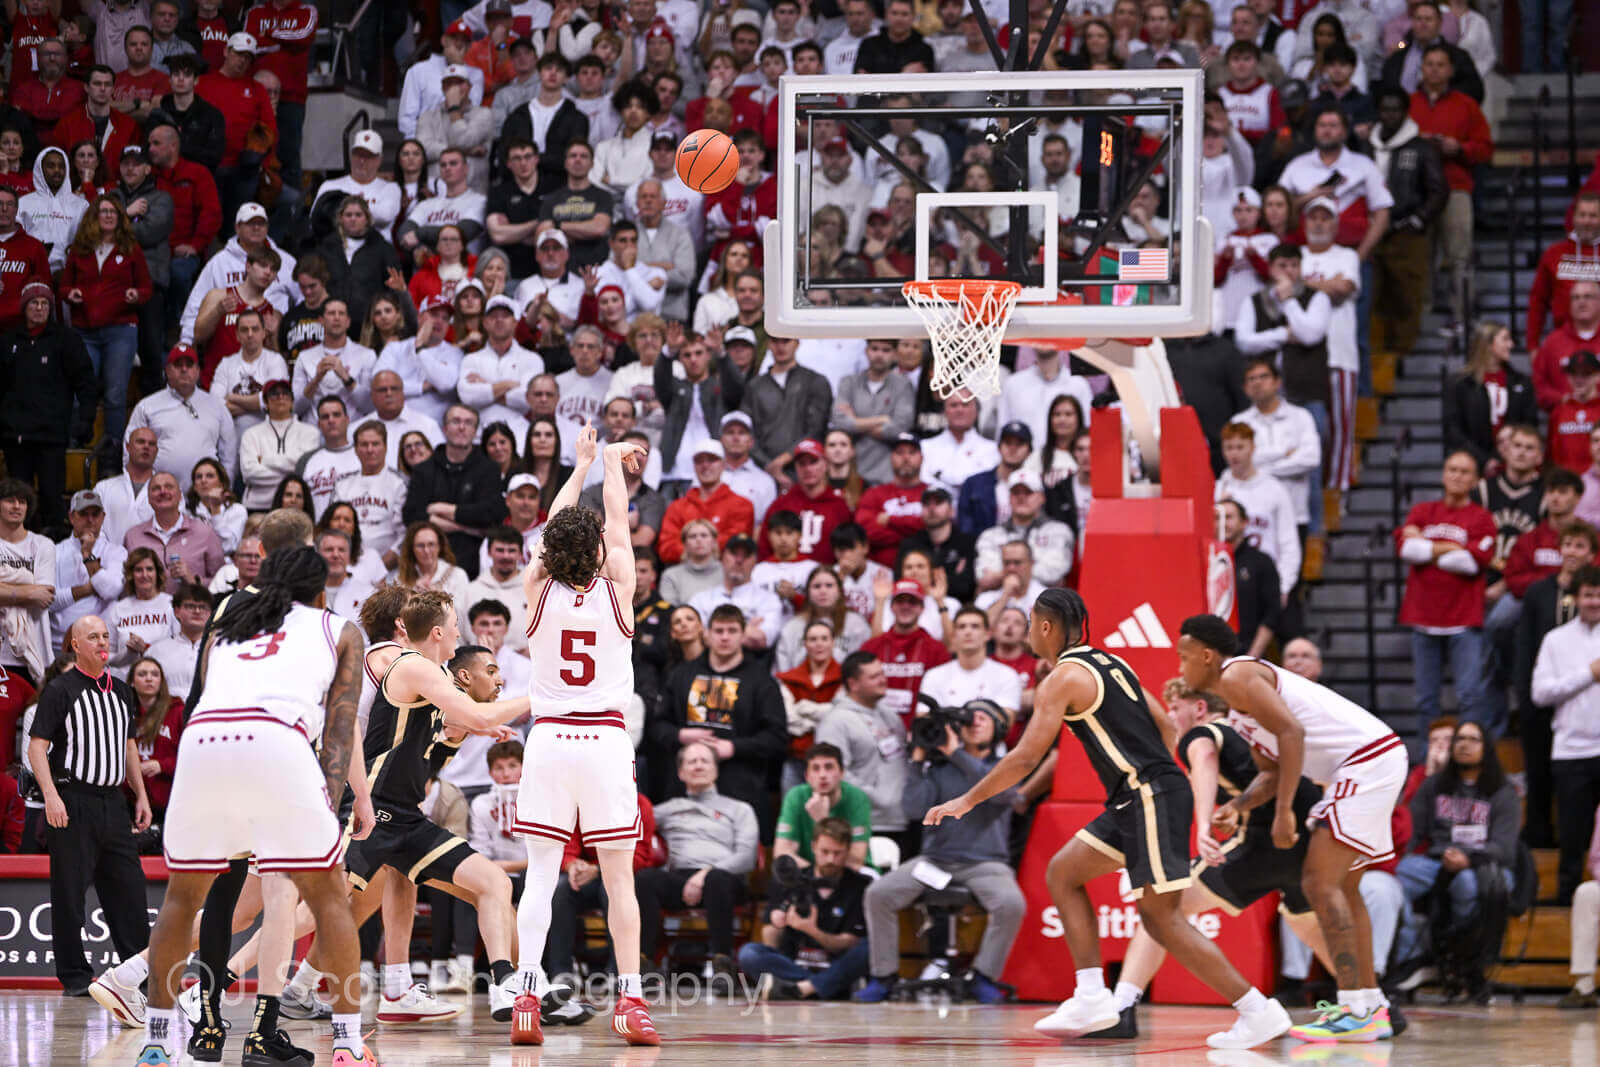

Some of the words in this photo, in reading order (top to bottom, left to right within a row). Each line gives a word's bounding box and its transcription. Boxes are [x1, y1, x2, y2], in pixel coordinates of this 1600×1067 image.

[118, 613, 168, 628] INDIANA
[238, 631, 286, 660] 3
[560, 630, 596, 686] 5
[26, 950, 38, 964] &
